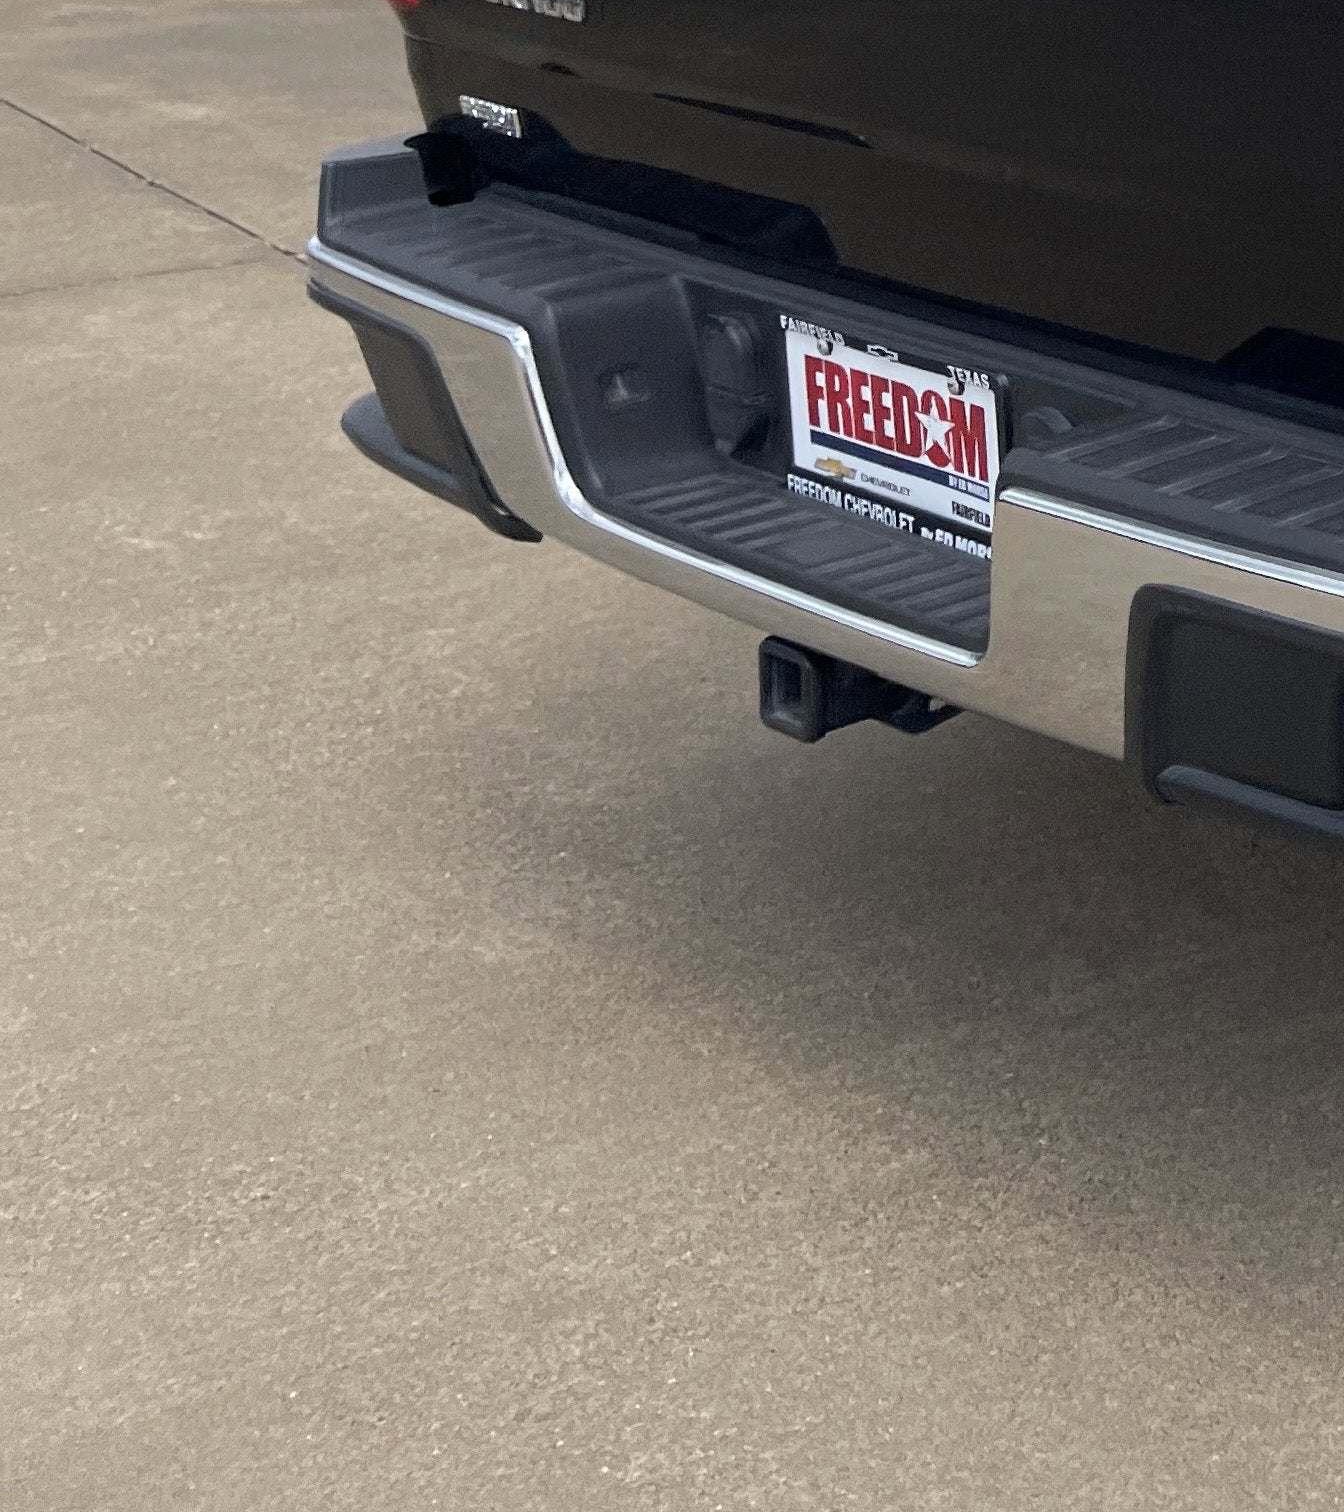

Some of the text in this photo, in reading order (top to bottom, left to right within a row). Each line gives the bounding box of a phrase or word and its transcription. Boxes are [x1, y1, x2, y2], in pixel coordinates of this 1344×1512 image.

[804, 354, 989, 483] FREEDOM
[787, 473, 842, 508] FREEDOM
[843, 492, 915, 534] CHEVROLET
